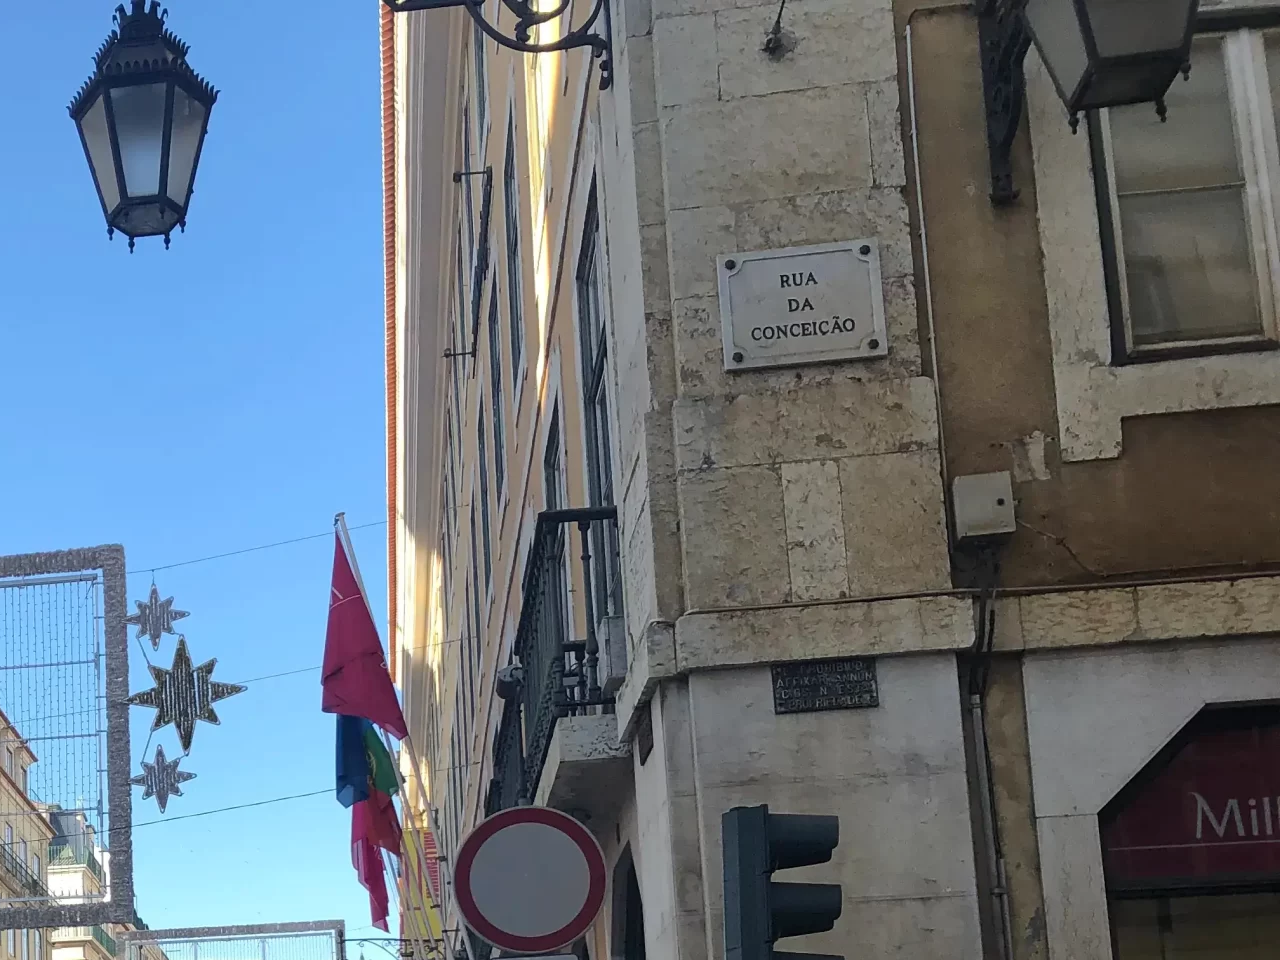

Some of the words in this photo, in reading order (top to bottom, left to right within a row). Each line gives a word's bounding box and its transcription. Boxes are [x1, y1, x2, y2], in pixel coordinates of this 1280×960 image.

[780, 272, 818, 288] RUA
[787, 298, 814, 312] DA
[751, 316, 856, 341] CONCEIÇÃO
